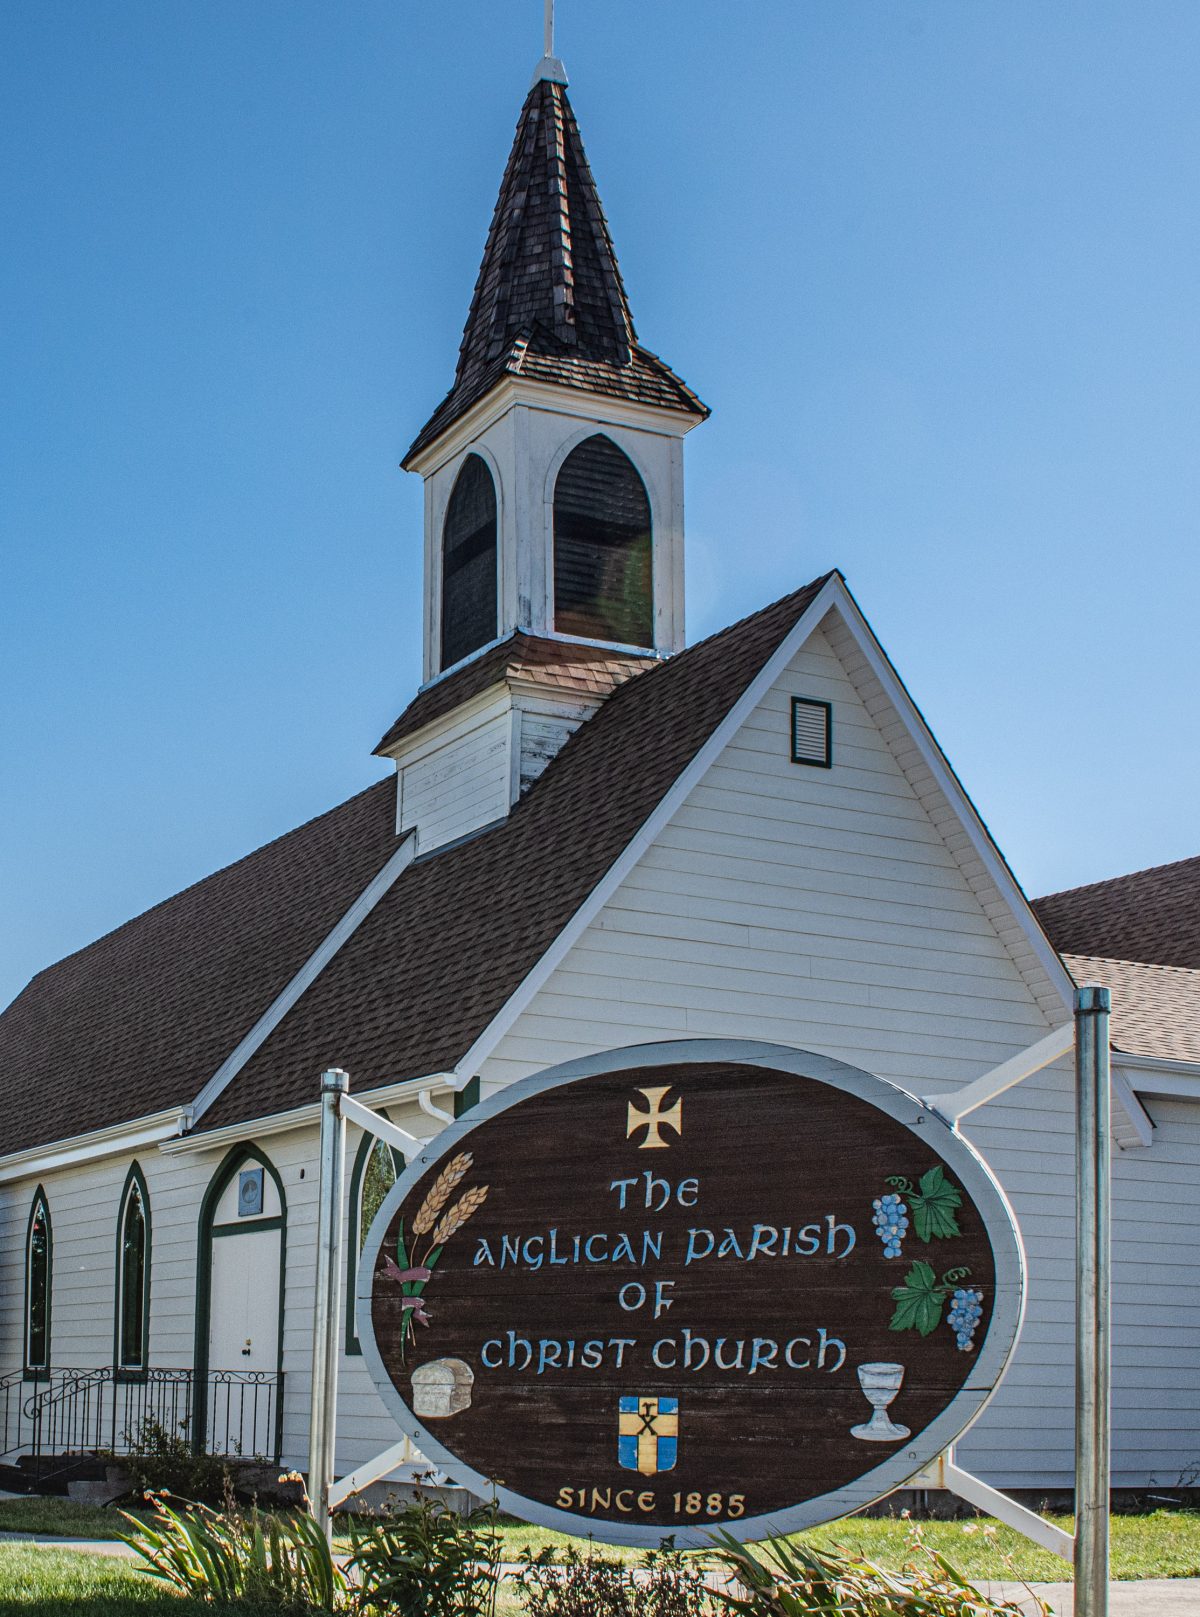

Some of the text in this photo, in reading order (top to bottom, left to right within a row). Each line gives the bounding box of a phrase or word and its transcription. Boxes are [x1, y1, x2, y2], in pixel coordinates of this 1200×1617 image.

[474, 1227, 663, 1271] ANGLICAN
[619, 1281, 676, 1319] OF
[555, 1486, 746, 1518] SINCE 1885
